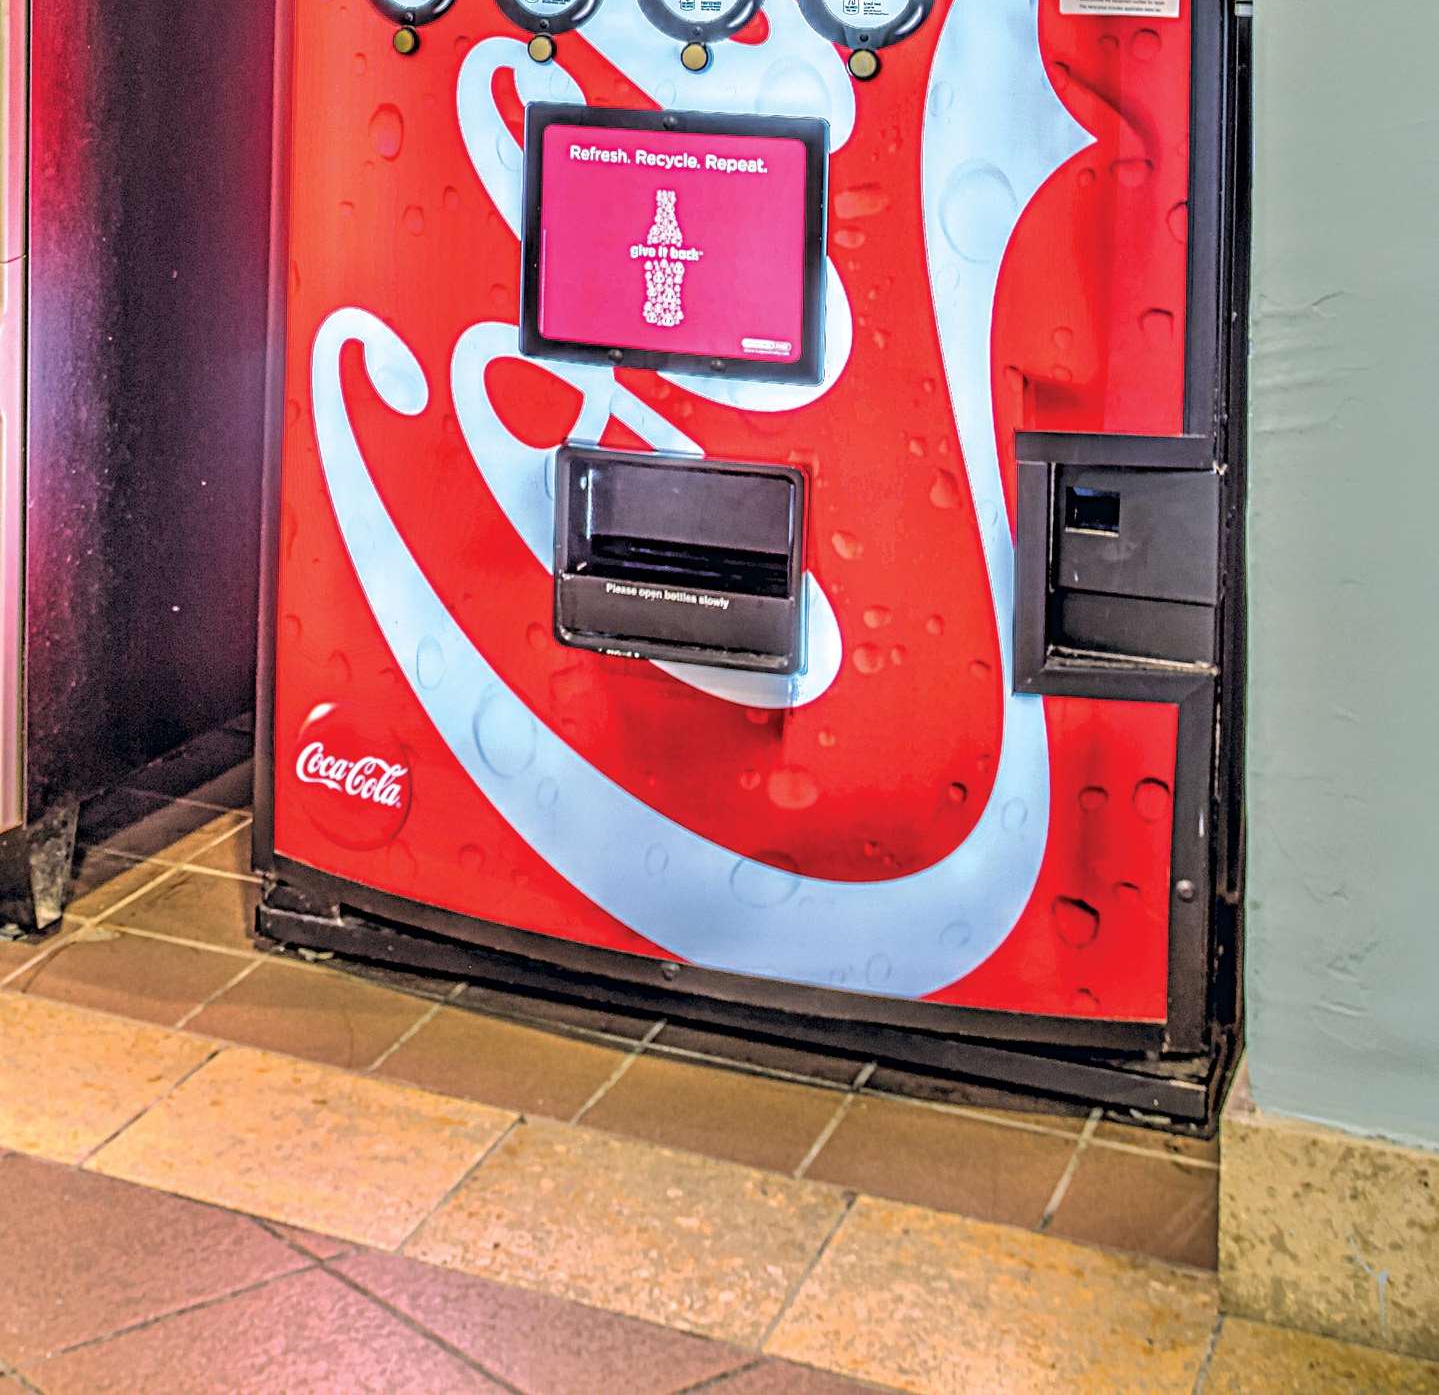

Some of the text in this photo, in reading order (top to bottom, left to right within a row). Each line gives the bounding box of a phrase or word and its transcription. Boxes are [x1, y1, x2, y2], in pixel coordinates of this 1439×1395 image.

[569, 145, 768, 174] Refresh. Recycle. Repeat.
[630, 244, 700, 261] give it back
[606, 583, 730, 610] Please open bottles slowly
[296, 741, 408, 809] Coca-Cola
